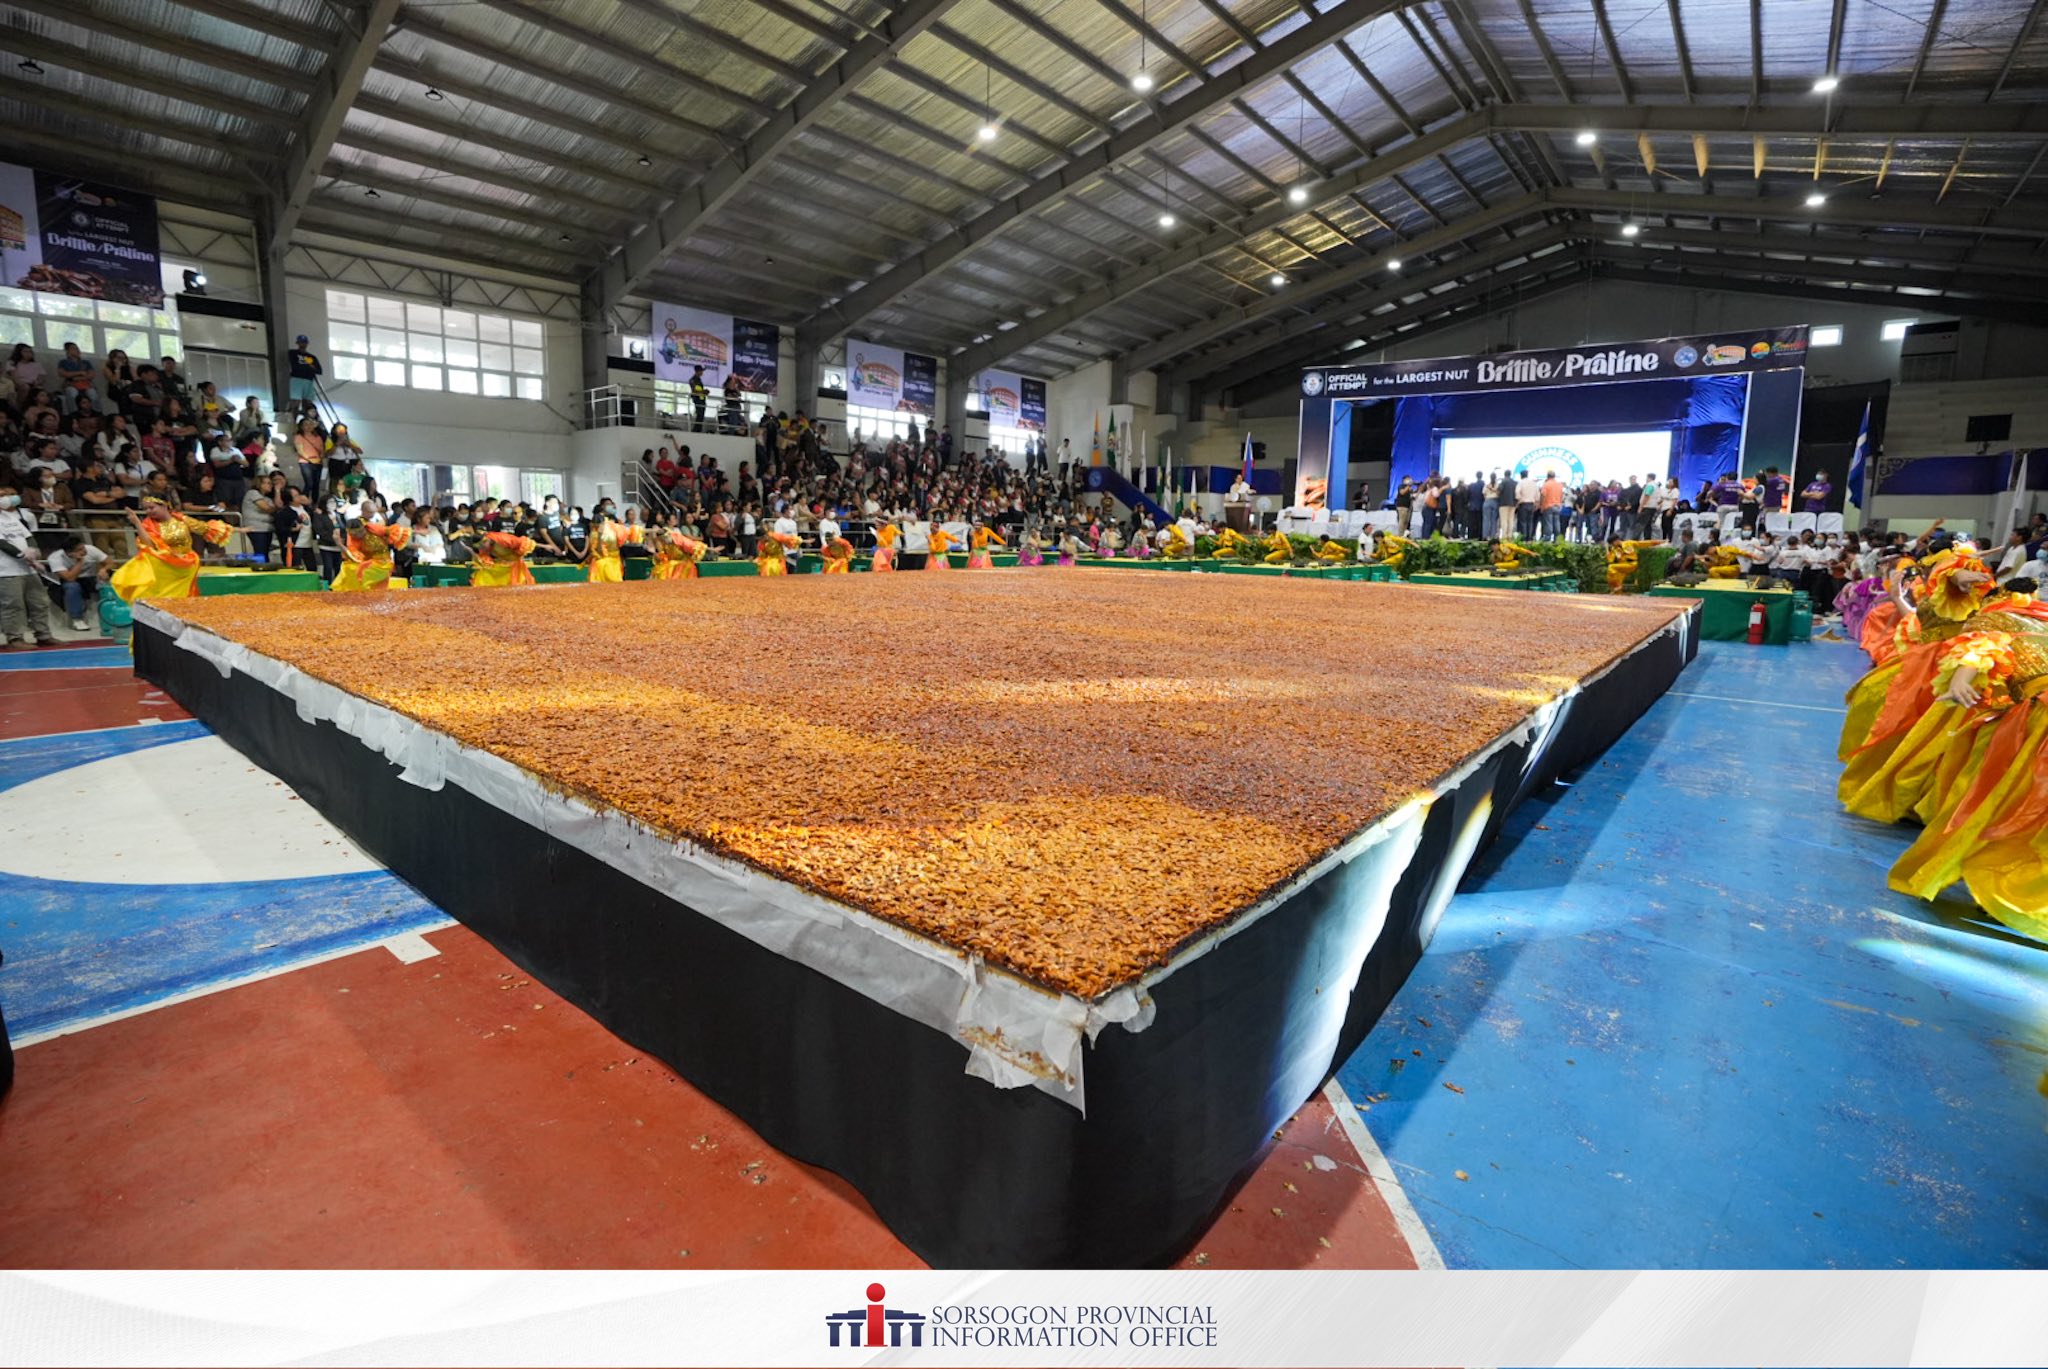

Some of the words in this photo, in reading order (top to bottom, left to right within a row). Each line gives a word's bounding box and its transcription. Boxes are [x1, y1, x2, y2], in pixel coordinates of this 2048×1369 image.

[1327, 373, 1368, 383] OFFICIAL
[1373, 377, 1383, 385] for
[1384, 377, 1395, 385] the
[1396, 371, 1443, 384] LARGEST
[1445, 369, 1470, 381] NUT
[1327, 382, 1368, 391] ATTEMPT
[1521, 446, 1578, 466] GUINNESS
